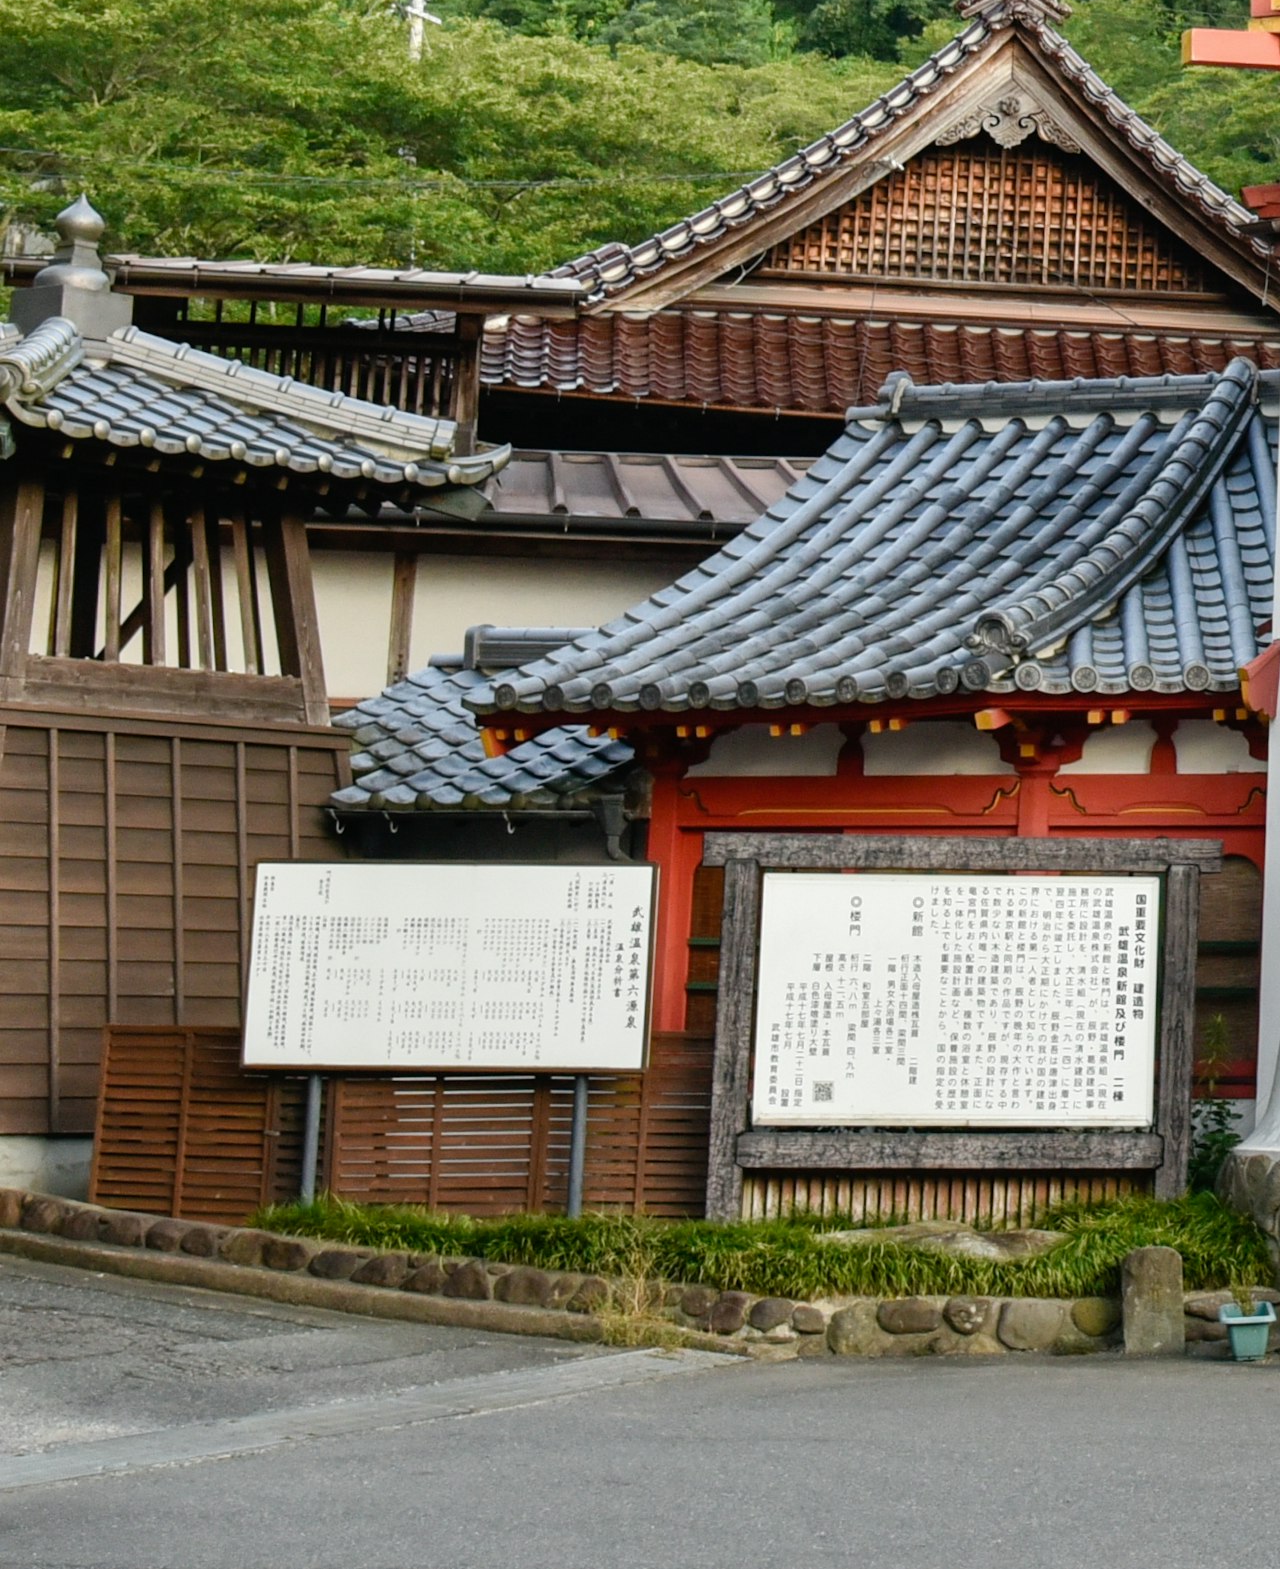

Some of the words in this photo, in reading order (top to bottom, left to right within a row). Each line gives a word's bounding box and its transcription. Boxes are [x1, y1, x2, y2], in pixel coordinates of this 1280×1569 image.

[625, 905, 645, 1029] 武雄温泉第六源泉
[1134, 894, 1146, 968] 国重要文化財
[1114, 926, 1129, 1060] 武雄温泉新館及び楼門
[1132, 983, 1144, 1020] 建造物
[769, 1024, 780, 1104] 武雄市教育委員会
[1112, 1078, 1124, 1102] 二棟
